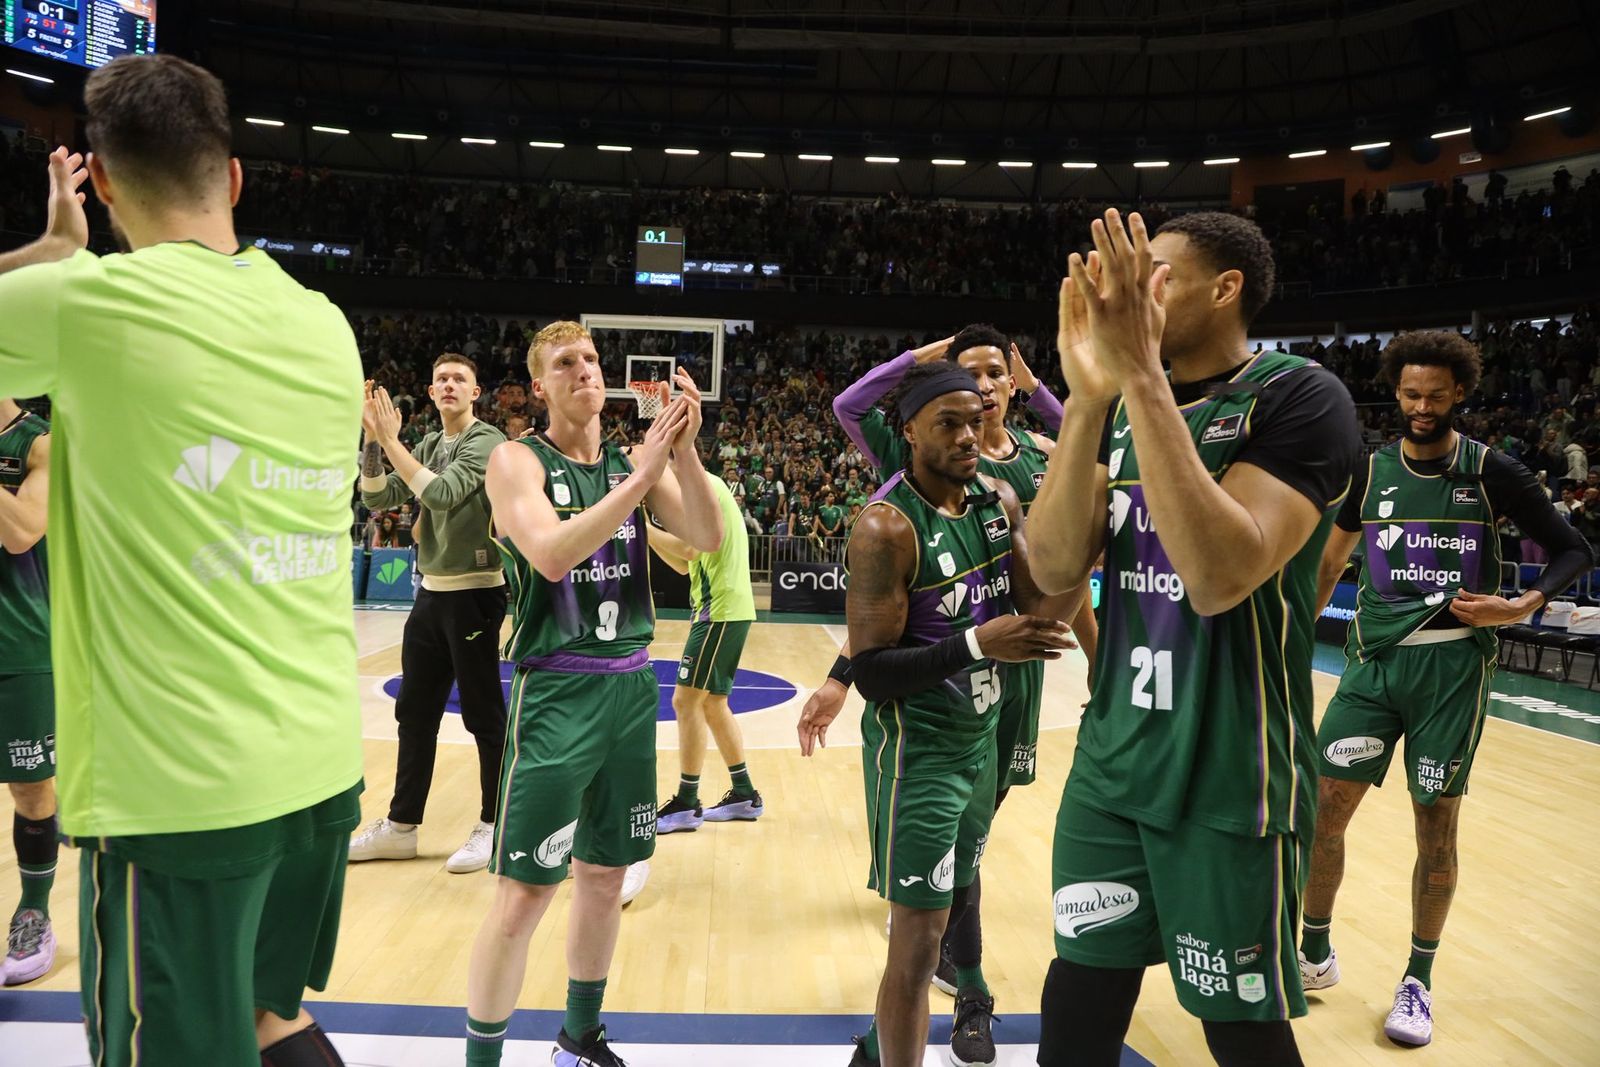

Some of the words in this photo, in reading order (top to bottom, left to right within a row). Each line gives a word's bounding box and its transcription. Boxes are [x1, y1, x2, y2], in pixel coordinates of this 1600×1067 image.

[27, 28, 37, 38] 5
[63, 39, 73, 49] 5
[324, 246, 350, 256] Uicaja
[1407, 533, 1477, 555] Unicaja
[1120, 561, 1185, 602] málag
[1130, 646, 1173, 711] 21
[1176, 933, 1210, 951] sabor
[1176, 946, 1185, 956] a
[1185, 948, 1230, 975] má
[1179, 957, 1231, 997] laga
